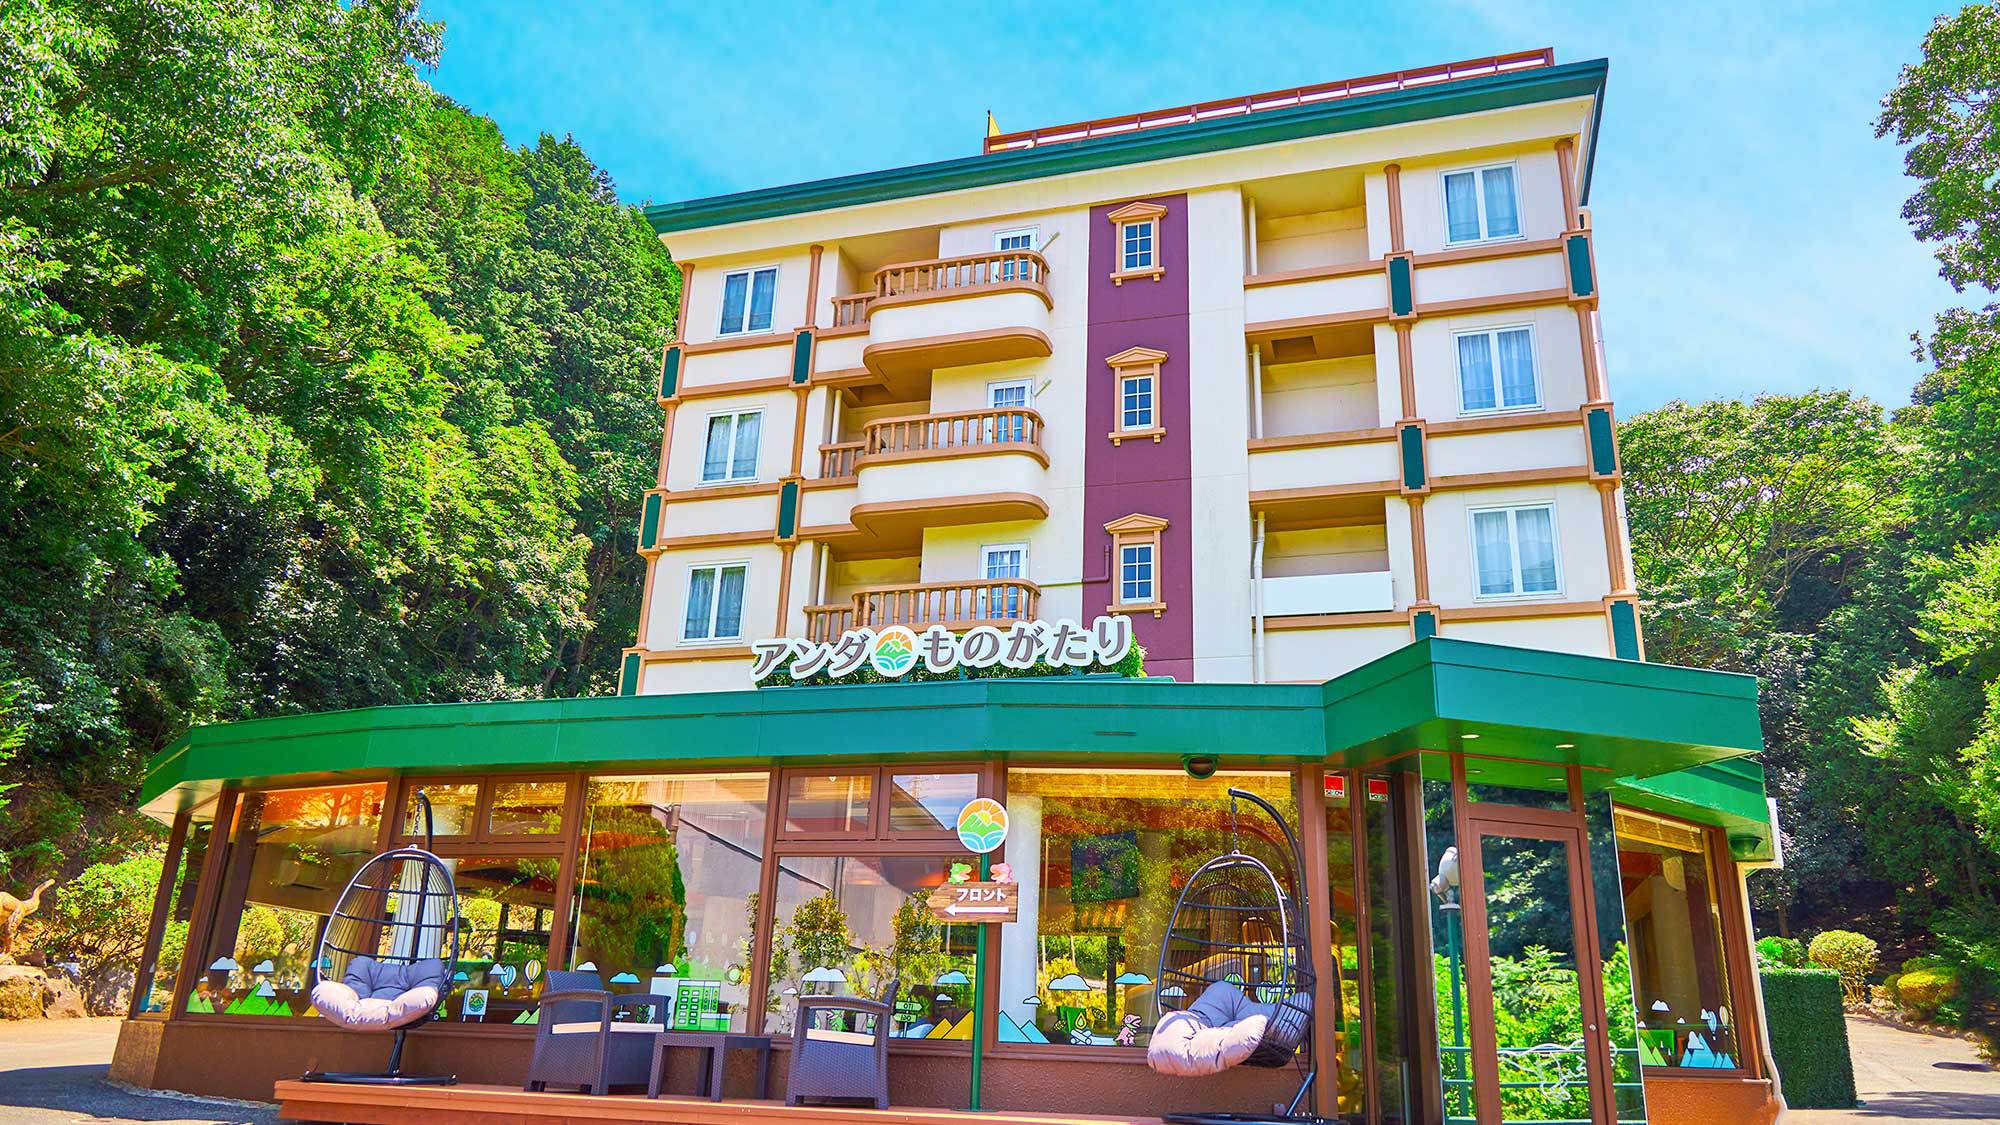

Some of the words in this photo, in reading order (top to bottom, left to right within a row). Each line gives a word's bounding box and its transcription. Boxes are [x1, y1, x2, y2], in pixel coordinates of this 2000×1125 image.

[754, 632, 871, 676] アンダ
[922, 620, 1126, 668] ものがたり
[956, 887, 1007, 903] フロント
